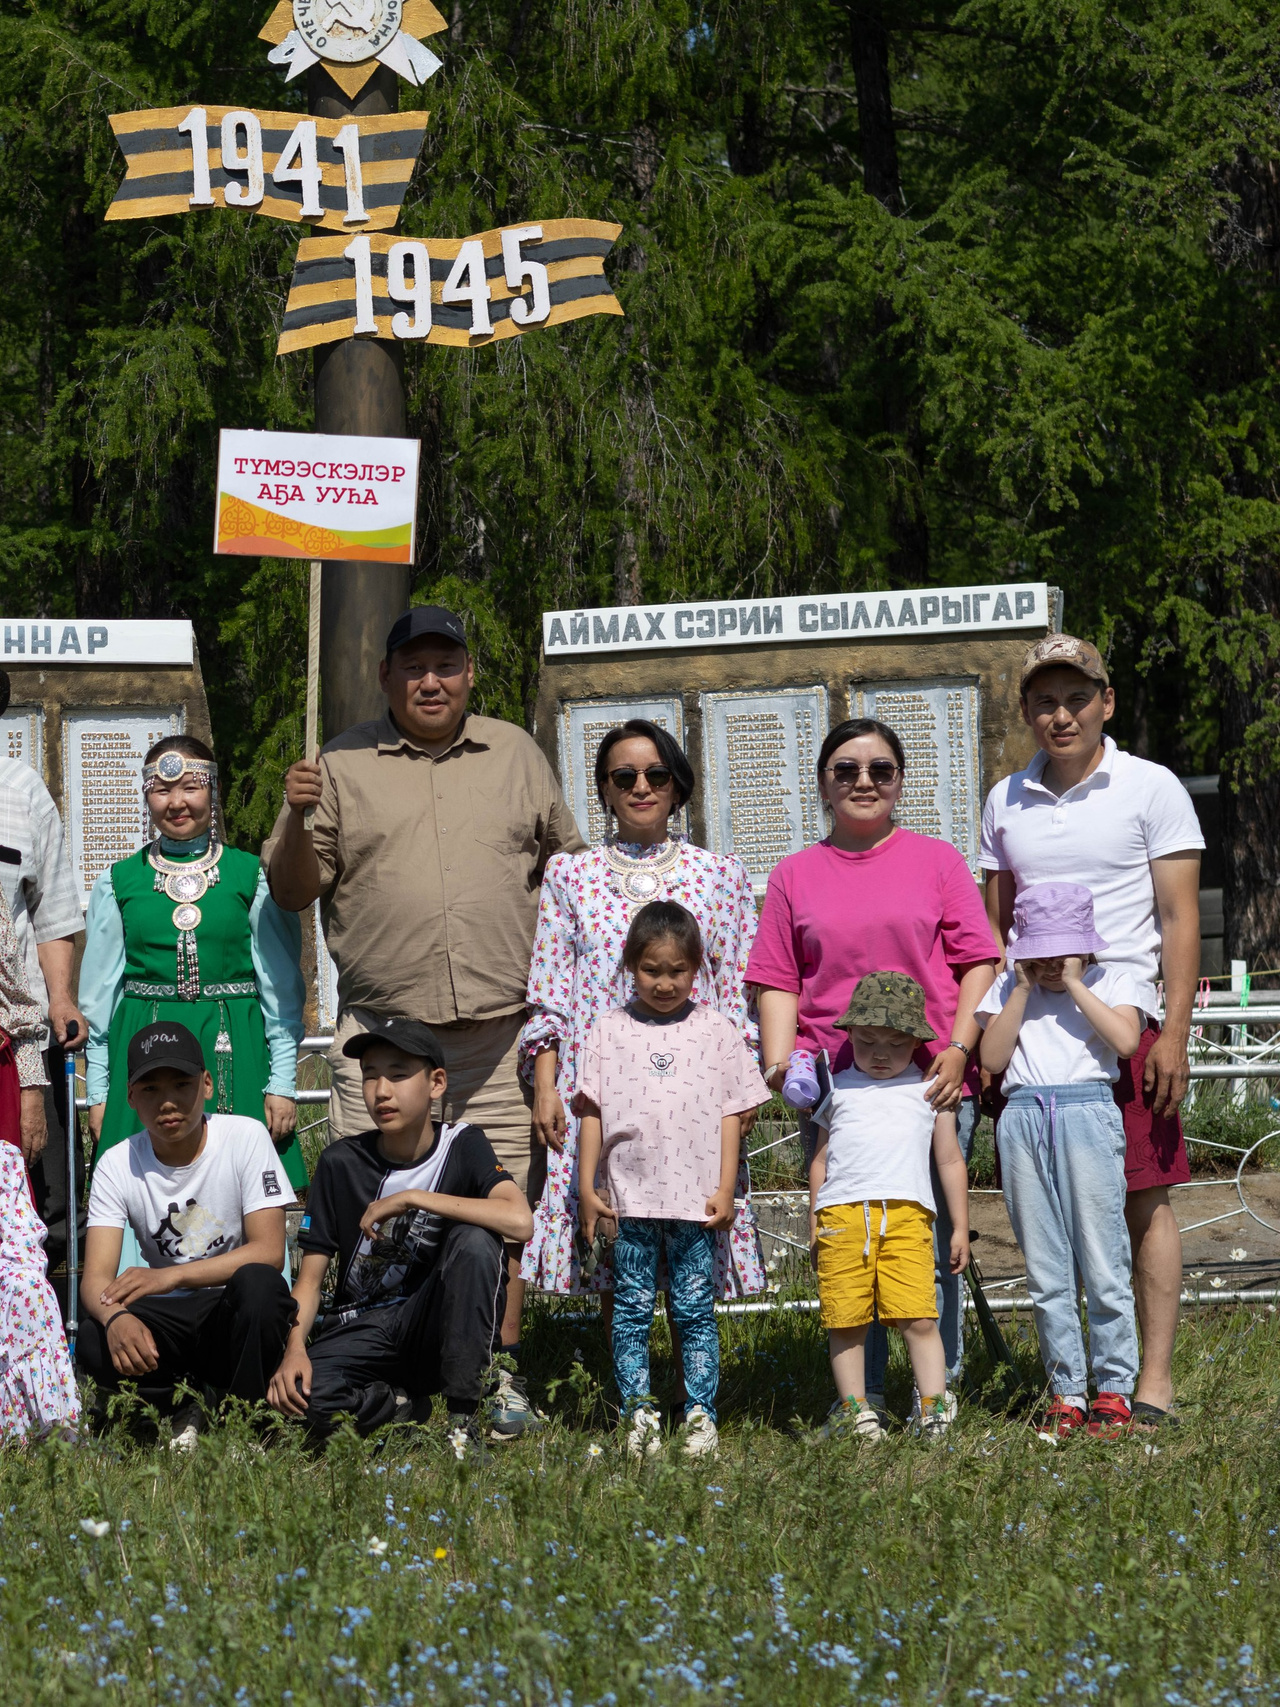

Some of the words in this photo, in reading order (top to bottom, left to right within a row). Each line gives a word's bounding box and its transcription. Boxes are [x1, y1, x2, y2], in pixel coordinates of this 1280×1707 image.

[178, 107, 370, 224] 1941
[343, 224, 552, 341] 1945
[234, 457, 406, 482] ТҮМЭЭСКЭЛЭР
[548, 610, 667, 647] АЙМАХ
[674, 604, 784, 640] СЭРИИ
[798, 590, 1036, 632] СЫЛЛАРЫГАР
[876, 703, 930, 714] ЦЫПАНДИН
[726, 712, 778, 724] ЦЫПАНДИН
[726, 722, 784, 733] ЦЫПАНДИНА
[81, 733, 130, 741] СТРУЧКОВА
[726, 732, 786, 743] ЦЫПАНДИНА
[81, 743, 131, 751] ЦЫПАНДИН
[727, 742, 786, 752] ЦЫПАНДИНА
[728, 750, 779, 761] ЦЫПАНДИН
[81, 761, 126, 769] ФЕДОРОВА
[728, 760, 787, 771] ЦЫПАНДИНА
[81, 770, 138, 778] ЦЫПАНДИНА
[82, 780, 133, 788] ЦЫПАНДИН
[82, 789, 139, 797] ЦЫПАНДИНА
[82, 798, 139, 806] ЦЫПАНДИНА
[730, 798, 783, 808] ЦЫПАНДИН
[83, 808, 140, 816] ЦЫПАНДИНА
[731, 807, 791, 817] ЦЫПАНДИНА
[83, 817, 140, 825] ЦЫПАНДИНА
[731, 816, 785, 826] ЦЫПАНДИН
[83, 826, 140, 835] ЦЫПАНДИНА
[732, 823, 792, 834] ЦЫПАНДИНА
[83, 835, 128, 843] БОРИСОВА
[733, 833, 793, 845] ЦЫПАНДИНА
[83, 843, 135, 852] ЦЫПАНДИН
